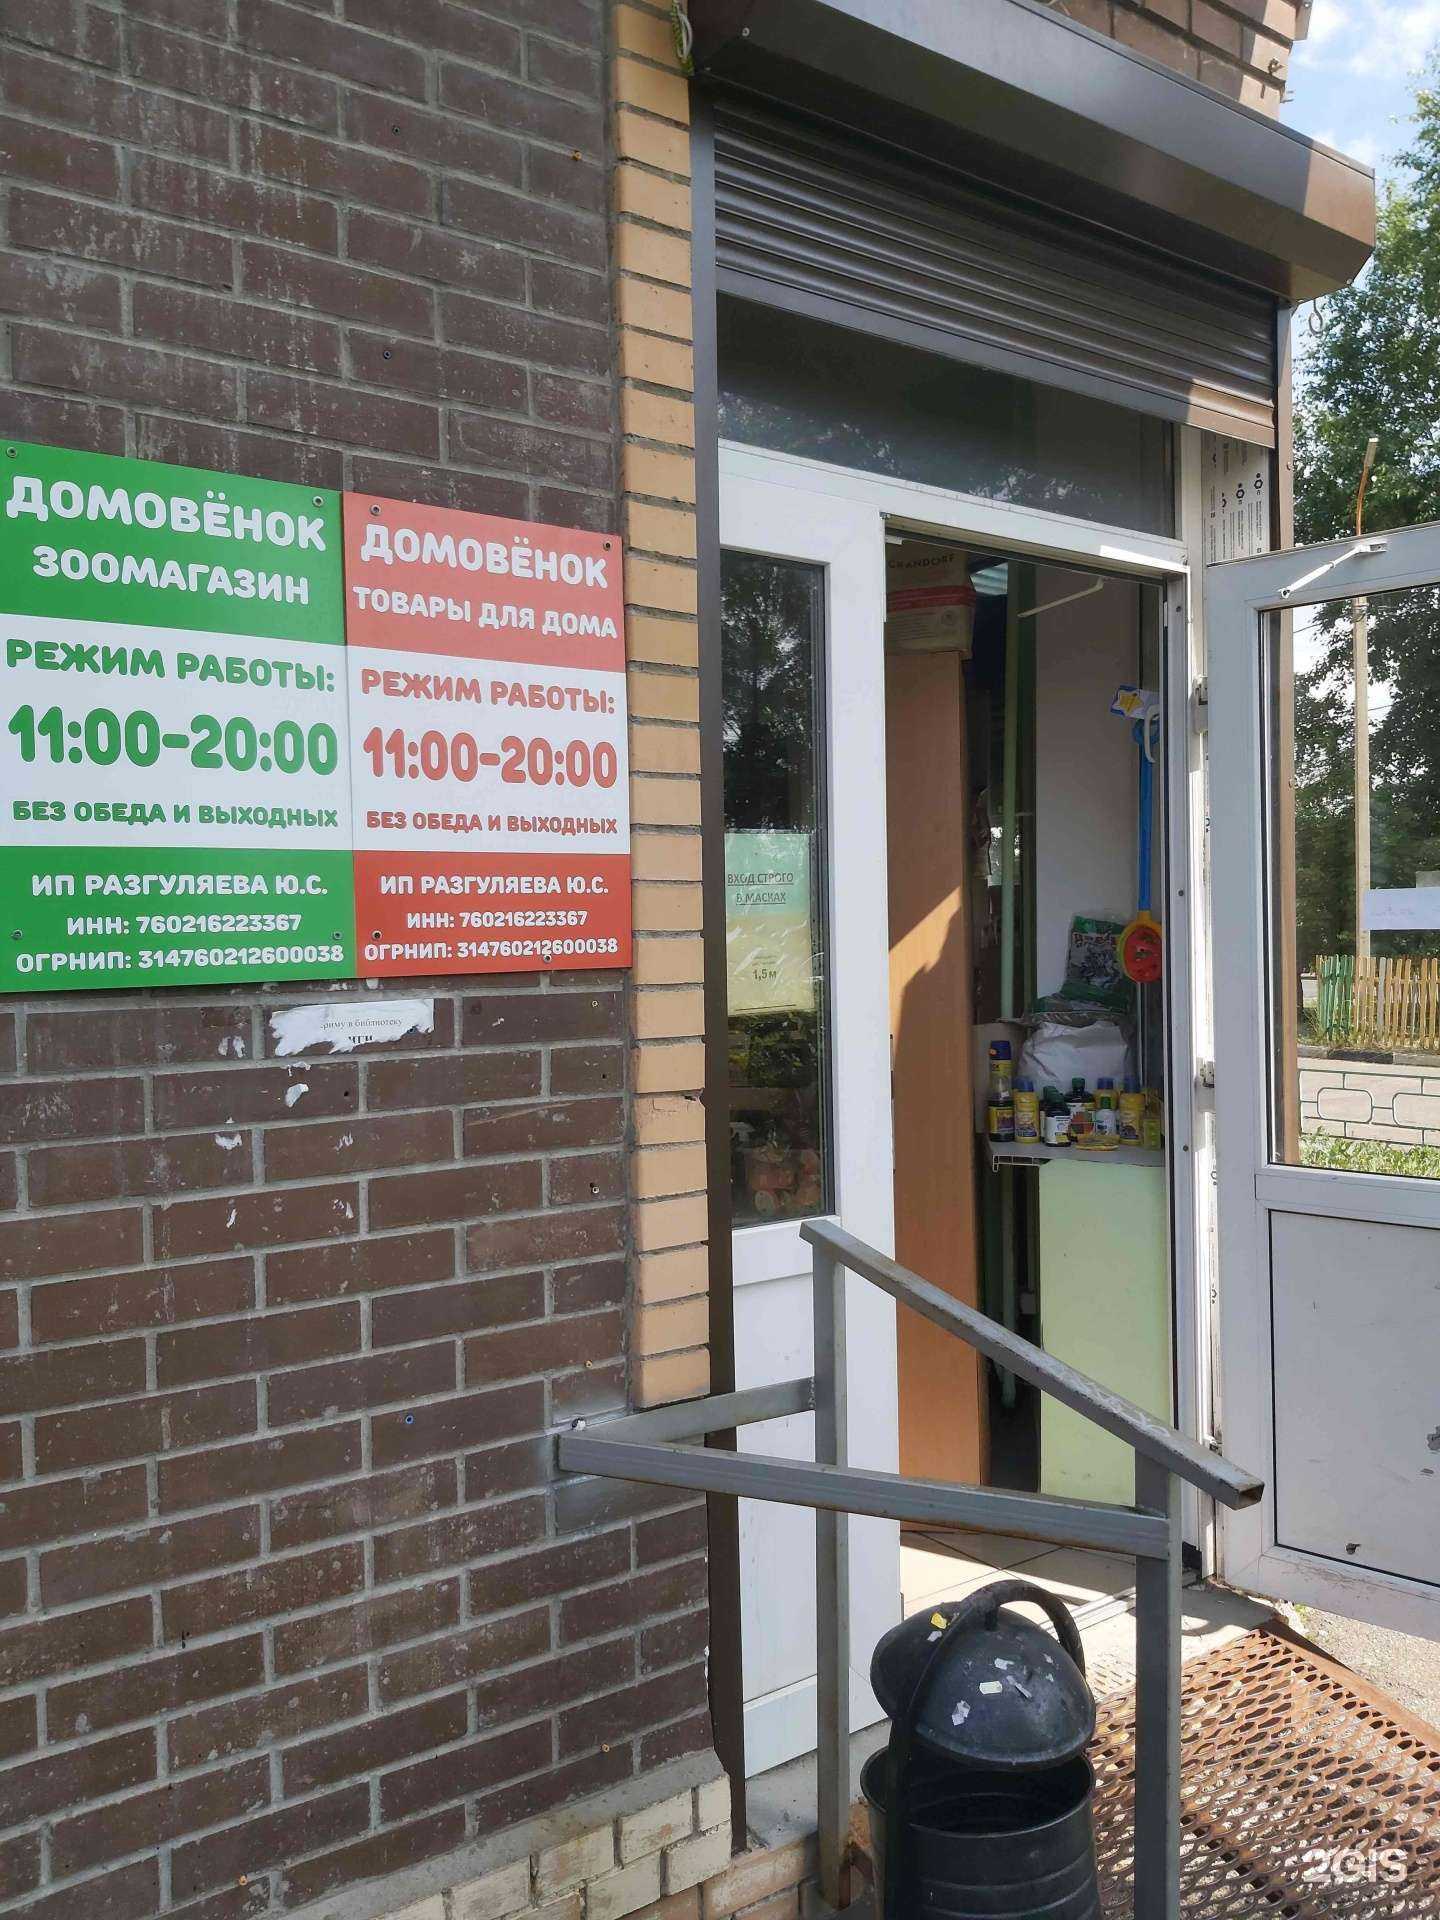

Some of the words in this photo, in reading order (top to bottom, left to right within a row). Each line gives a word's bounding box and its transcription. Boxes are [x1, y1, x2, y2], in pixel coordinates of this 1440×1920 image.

[6, 475, 326, 552] ДОМОВЁНОК
[360, 523, 608, 588] ДОМОВЁНОК
[32, 545, 309, 605] ЗООМАГАЗИН
[352, 586, 471, 622] ТОВАРЫ
[478, 603, 535, 630] ДЛЯ
[542, 610, 618, 639] ДОМА
[6, 638, 166, 678] РЕЖИМ
[176, 652, 335, 692] РАБОТЫ:
[361, 668, 482, 703] РЕЖИМ
[490, 681, 615, 714] РАБОТЫ:
[8, 704, 338, 776] 11:00-20:00
[363, 726, 618, 788] 11:00-20:00
[12, 800, 66, 821] БЕЗ
[73, 801, 166, 826] ОБЕДА
[173, 804, 191, 823] И
[198, 805, 338, 828] ВЫХОДНЫХ
[366, 810, 407, 829] БЕЗ
[412, 812, 482, 833] ОБЕДА
[487, 814, 501, 832] И
[507, 815, 618, 836] ВЫХОДНЫХ
[31, 875, 75, 896] ИП
[85, 874, 268, 896] РАЗГУЛЯЕВА
[275, 875, 328, 896] Ю.С.
[380, 876, 413, 895] ИП
[421, 875, 562, 895] РАЗГУЛЯЕВА
[567, 876, 609, 895] Ю.С.
[728, 872, 755, 885] ВХОД
[757, 872, 794, 884] СТРОГО
[745, 891, 787, 903] МАСКАХ
[66, 917, 130, 936] ИНН:
[136, 914, 302, 934] 760216223367
[407, 912, 455, 929] ИНН:
[459, 910, 588, 928] 760216223367
[16, 951, 132, 973] ОГРНИП:
[138, 944, 344, 969] 314760212600038
[364, 942, 453, 961] ОГРНИП:
[457, 937, 618, 958] 314760212600038
[320, 1020, 346, 1031] риму
